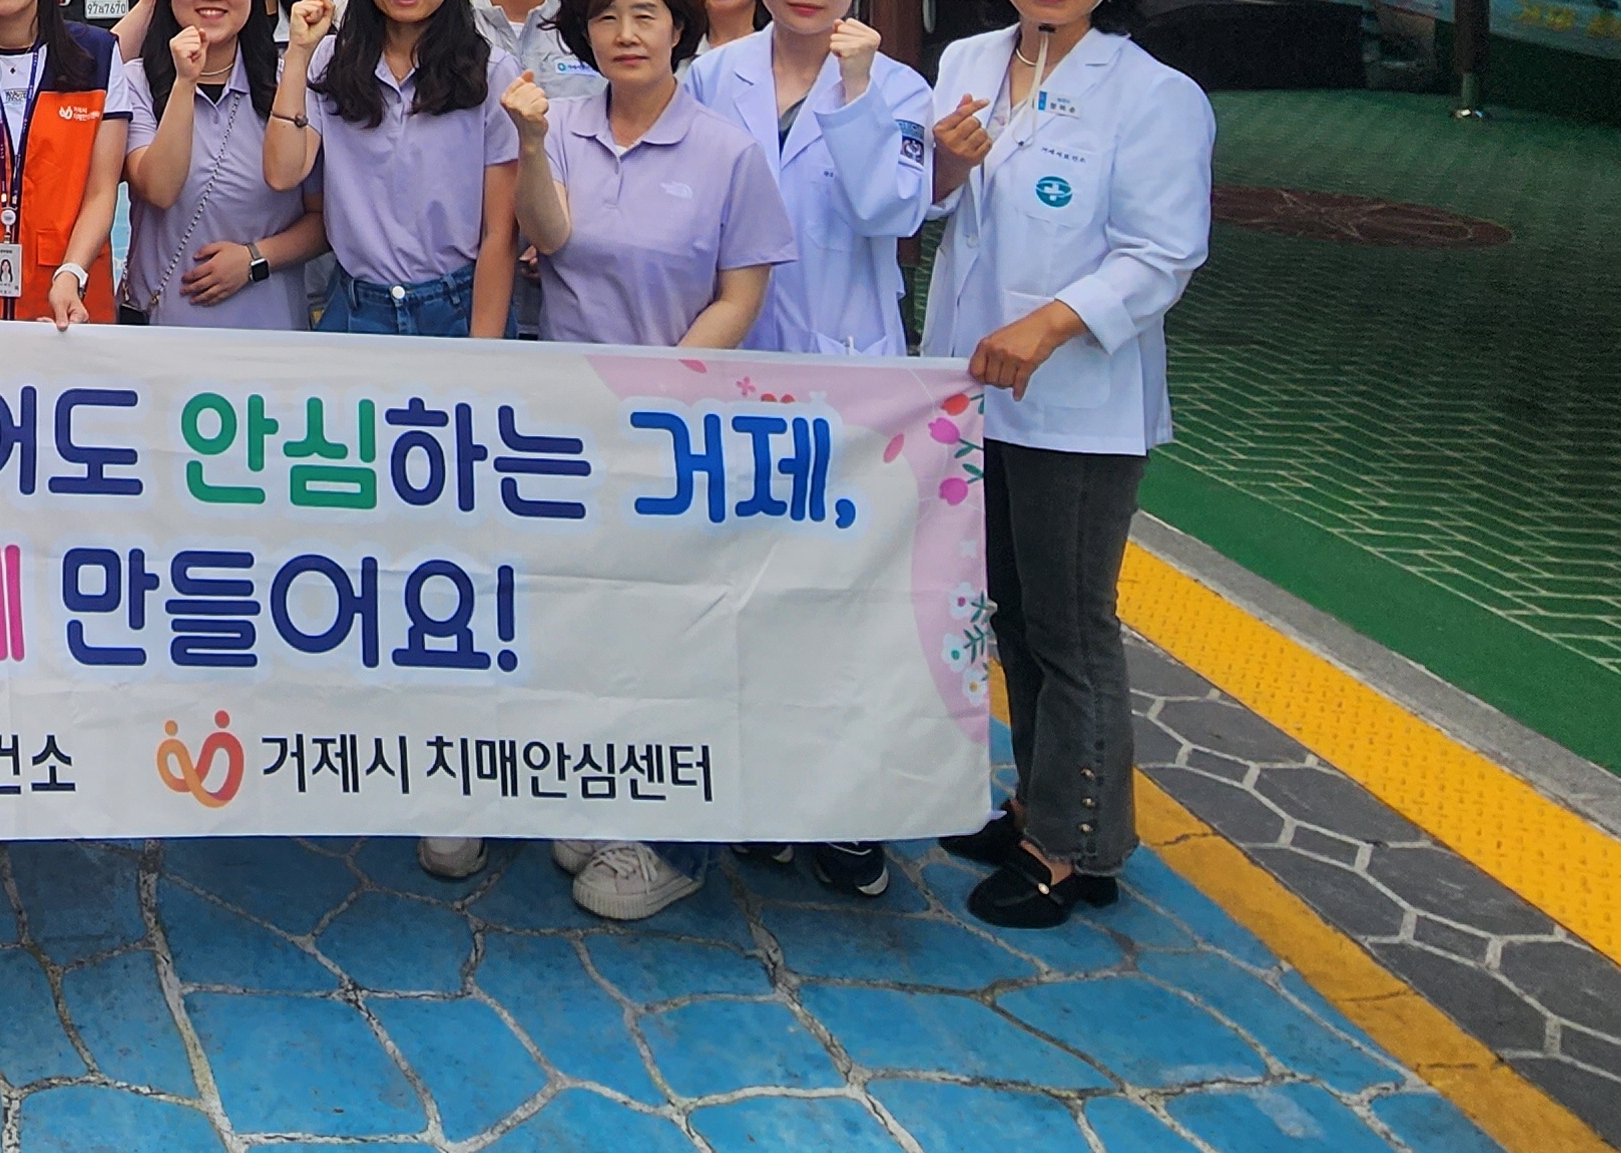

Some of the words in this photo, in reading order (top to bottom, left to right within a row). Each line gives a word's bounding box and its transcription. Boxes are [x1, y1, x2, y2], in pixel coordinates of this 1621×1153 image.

[181, 389, 593, 522] 안심하는
[632, 409, 857, 531] 거제,
[62, 545, 519, 674] 만들어요!
[262, 733, 412, 796] 거제시
[426, 733, 715, 804] 치매안심센터
